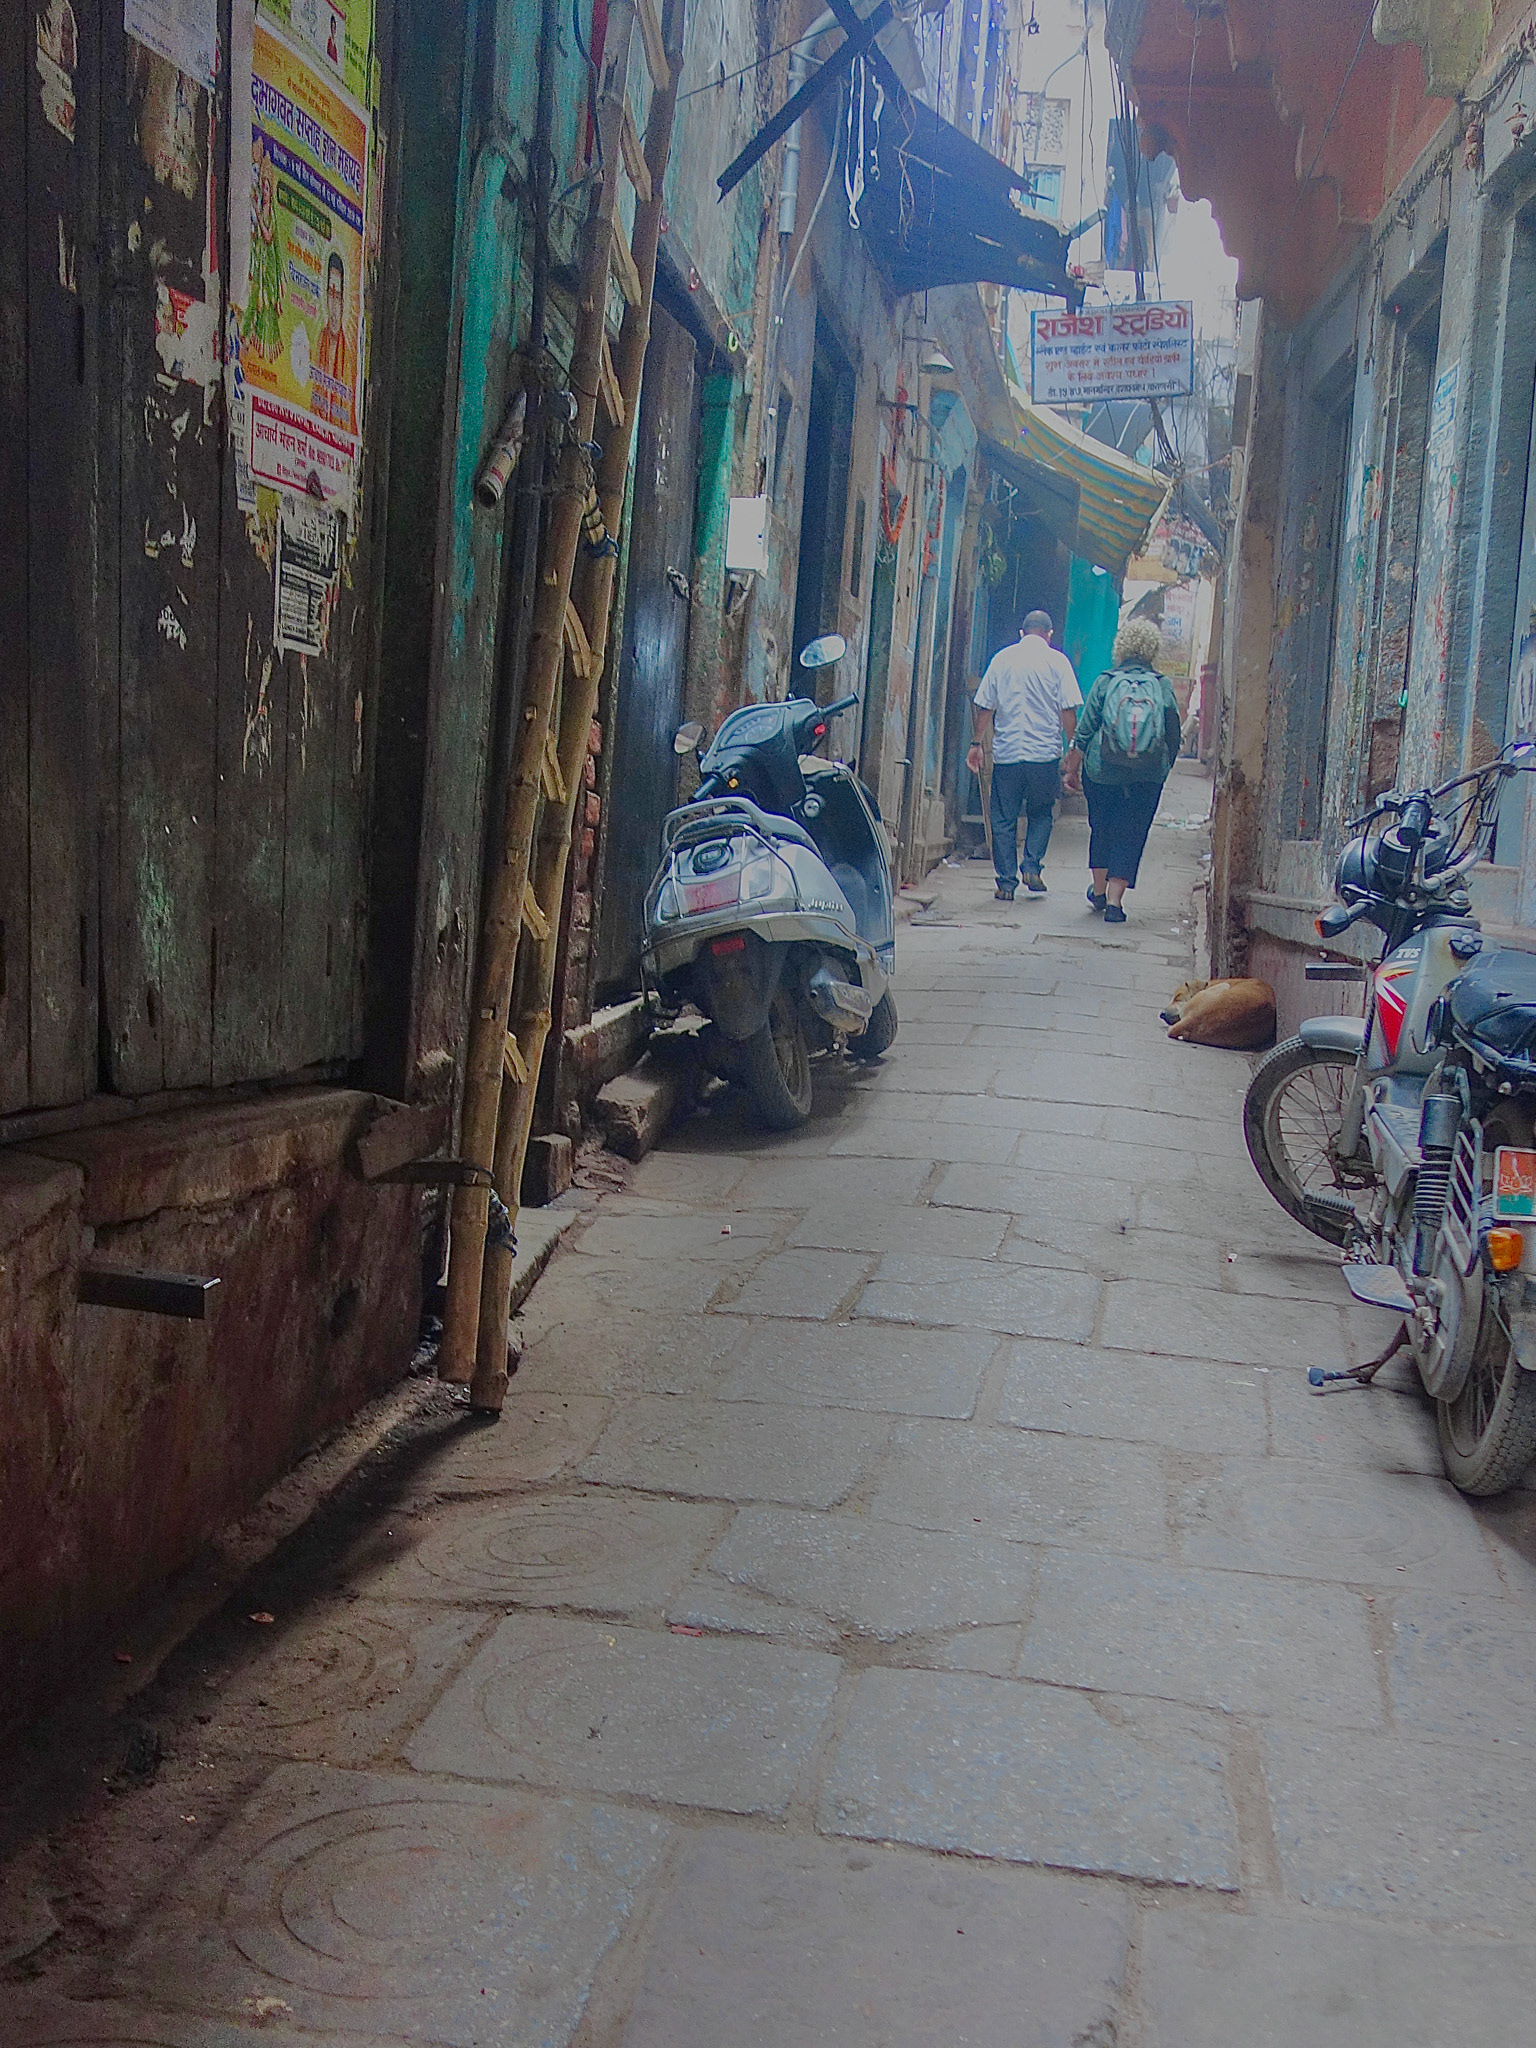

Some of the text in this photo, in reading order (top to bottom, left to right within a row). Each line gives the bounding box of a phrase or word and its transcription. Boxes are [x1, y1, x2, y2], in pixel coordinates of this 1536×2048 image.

[1036, 312, 1104, 341] राजेश
[255, 422, 277, 445] आचार्य
[1396, 947, 1422, 959] TVS
